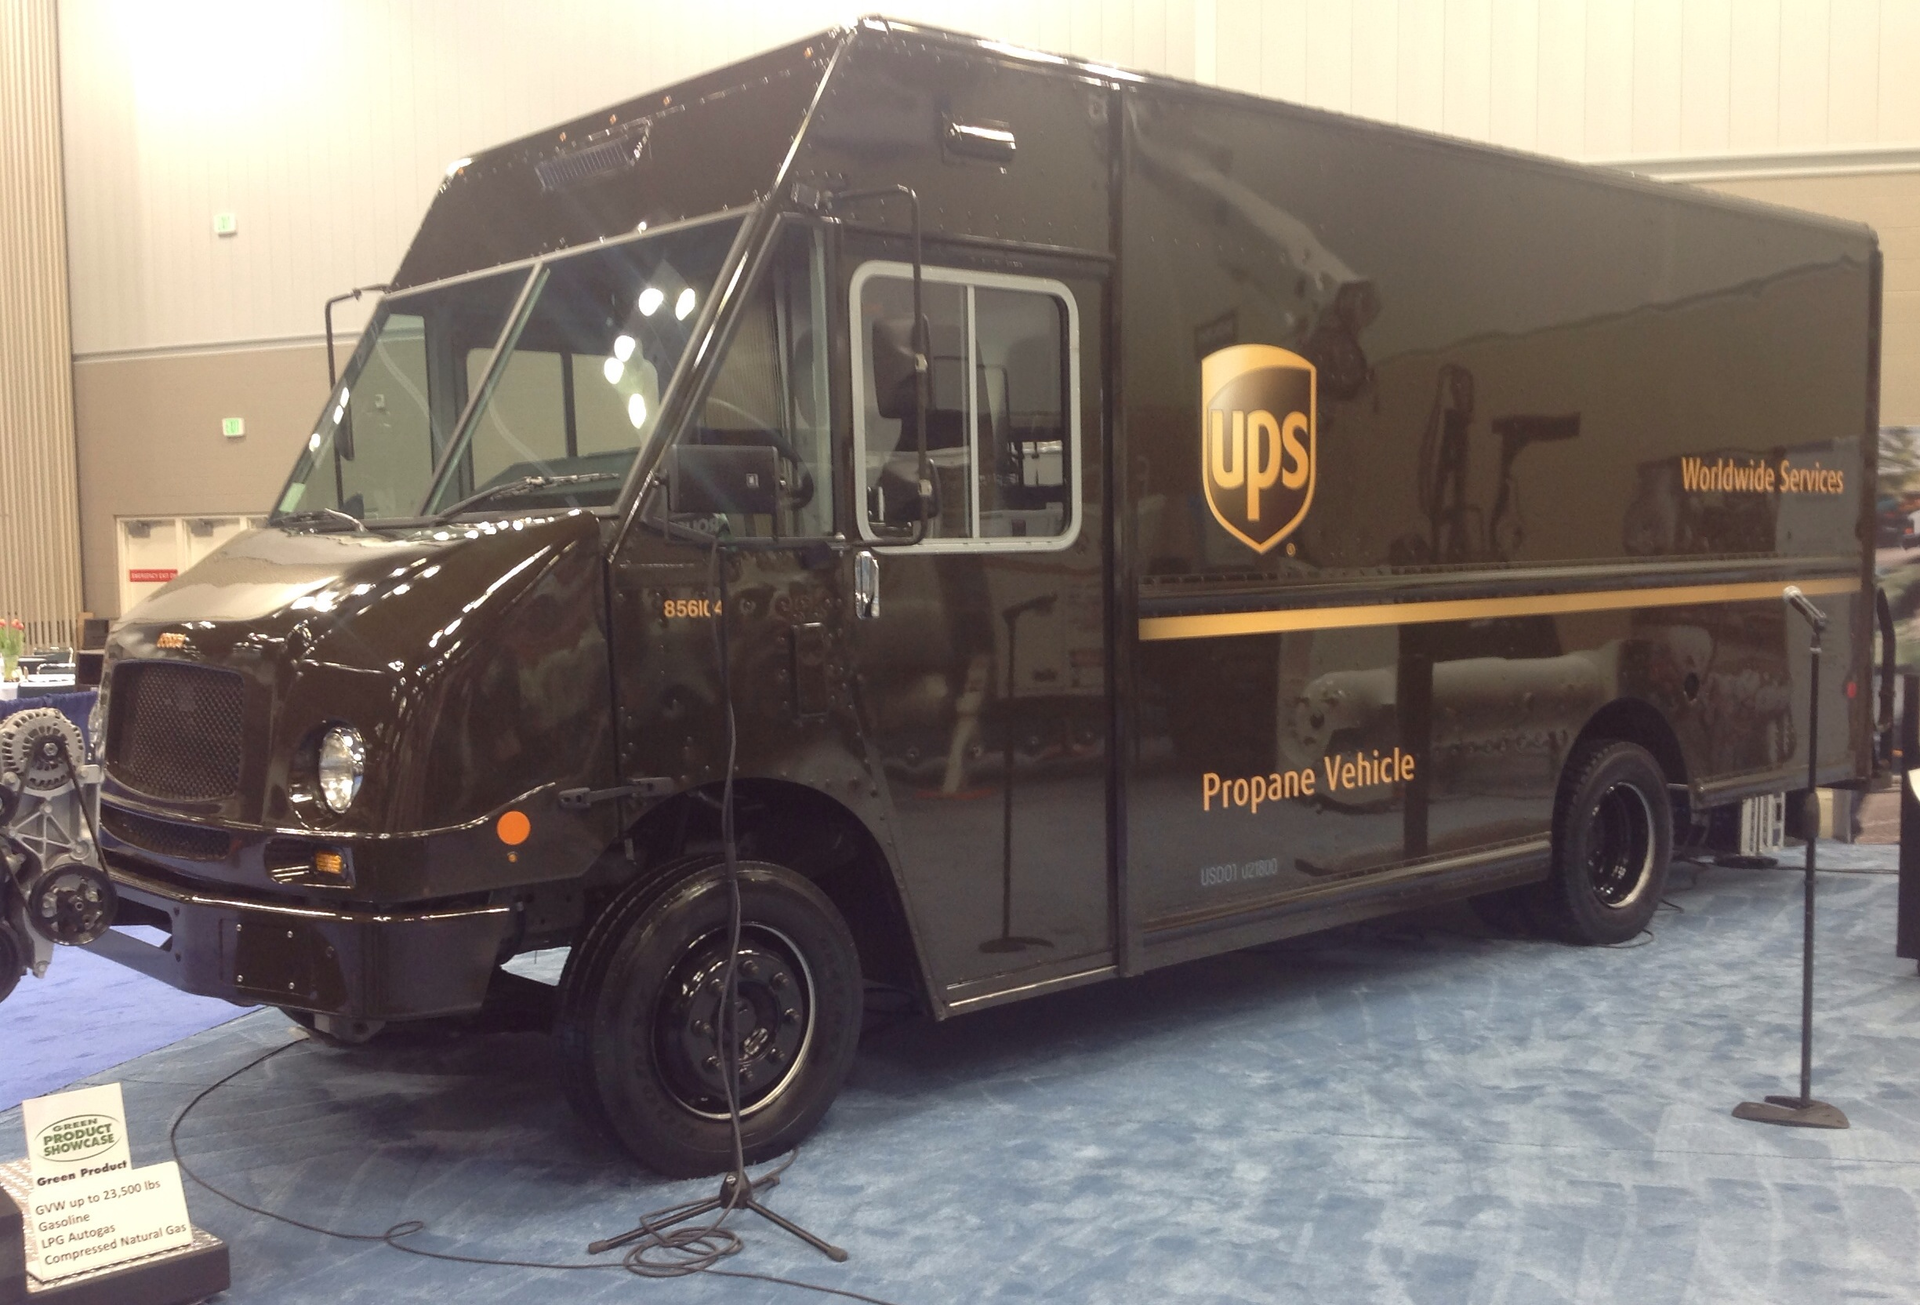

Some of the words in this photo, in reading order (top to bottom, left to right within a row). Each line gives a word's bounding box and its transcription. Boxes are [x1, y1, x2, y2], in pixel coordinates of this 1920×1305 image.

[1681, 457, 1775, 493] Worldwide
[1780, 459, 1844, 494] Services
[1203, 768, 1316, 814] Propane
[1324, 747, 1415, 791] Vehicle
[43, 1123, 112, 1146] PRODUCT
[52, 1118, 98, 1132] GREEN
[43, 1133, 115, 1157] SHOWCASE
[37, 1173, 76, 1186] Green
[80, 1160, 128, 1177] Product
[35, 1200, 66, 1216] GVW
[69, 1198, 85, 1210] up
[87, 1194, 100, 1204] to
[103, 1183, 142, 1200] 23,500
[144, 1180, 161, 1191] lbs
[38, 1213, 91, 1232] Gasoline
[41, 1235, 65, 1249] LPG
[68, 1224, 116, 1243] Autogas
[44, 1239, 118, 1265] Compressed
[120, 1227, 163, 1247] Natural
[165, 1223, 187, 1236] Gas
